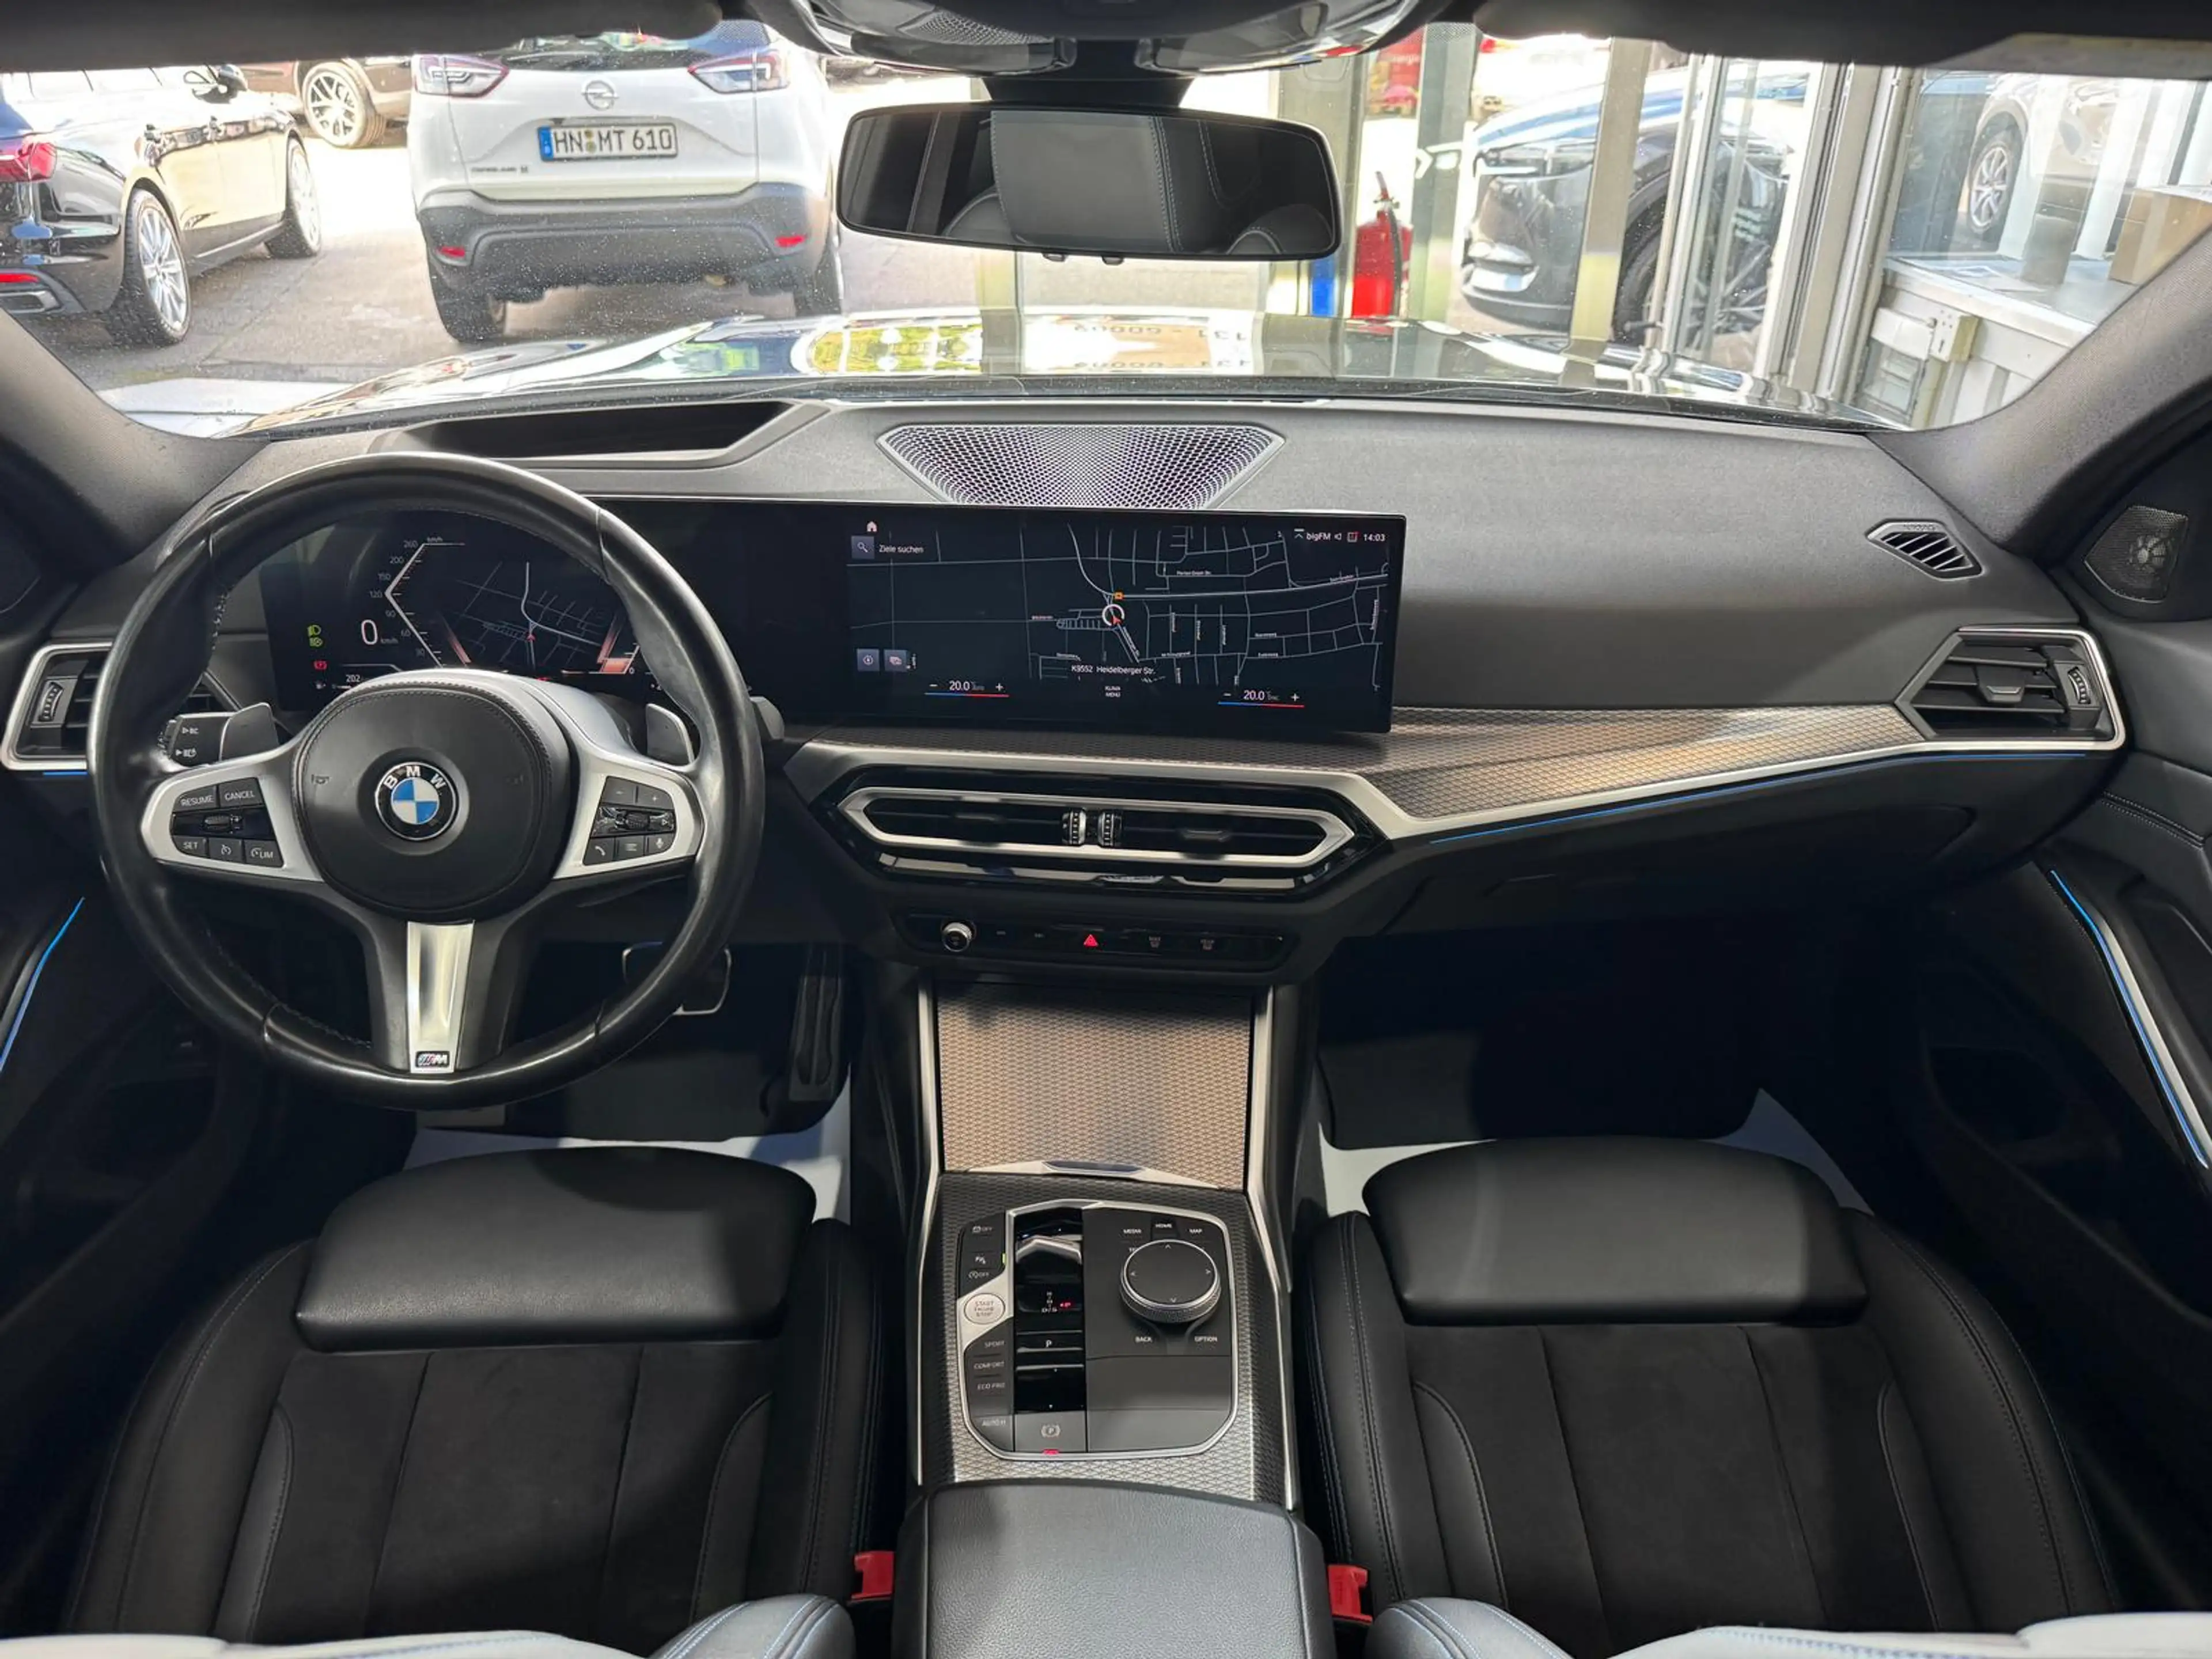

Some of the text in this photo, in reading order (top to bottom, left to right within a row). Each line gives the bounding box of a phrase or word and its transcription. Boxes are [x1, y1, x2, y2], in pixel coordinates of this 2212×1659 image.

[554, 128, 673, 153] HN MT 610
[1306, 532, 1385, 541] bigFM 14:03
[878, 544, 924, 554] Ziele suchen
[389, 556, 404, 564] 200
[361, 619, 378, 645] 0
[1096, 666, 1142, 675] Heidelberger
[1143, 666, 1156, 675] Str.
[346, 674, 361, 683] 202
[949, 680, 970, 691] 20.0
[1243, 690, 1265, 700] 20.0
[384, 766, 446, 790] BMW
[181, 795, 214, 806] RESUME
[225, 790, 255, 801] CANCEL
[974, 1361, 1005, 1370] COMFORT
